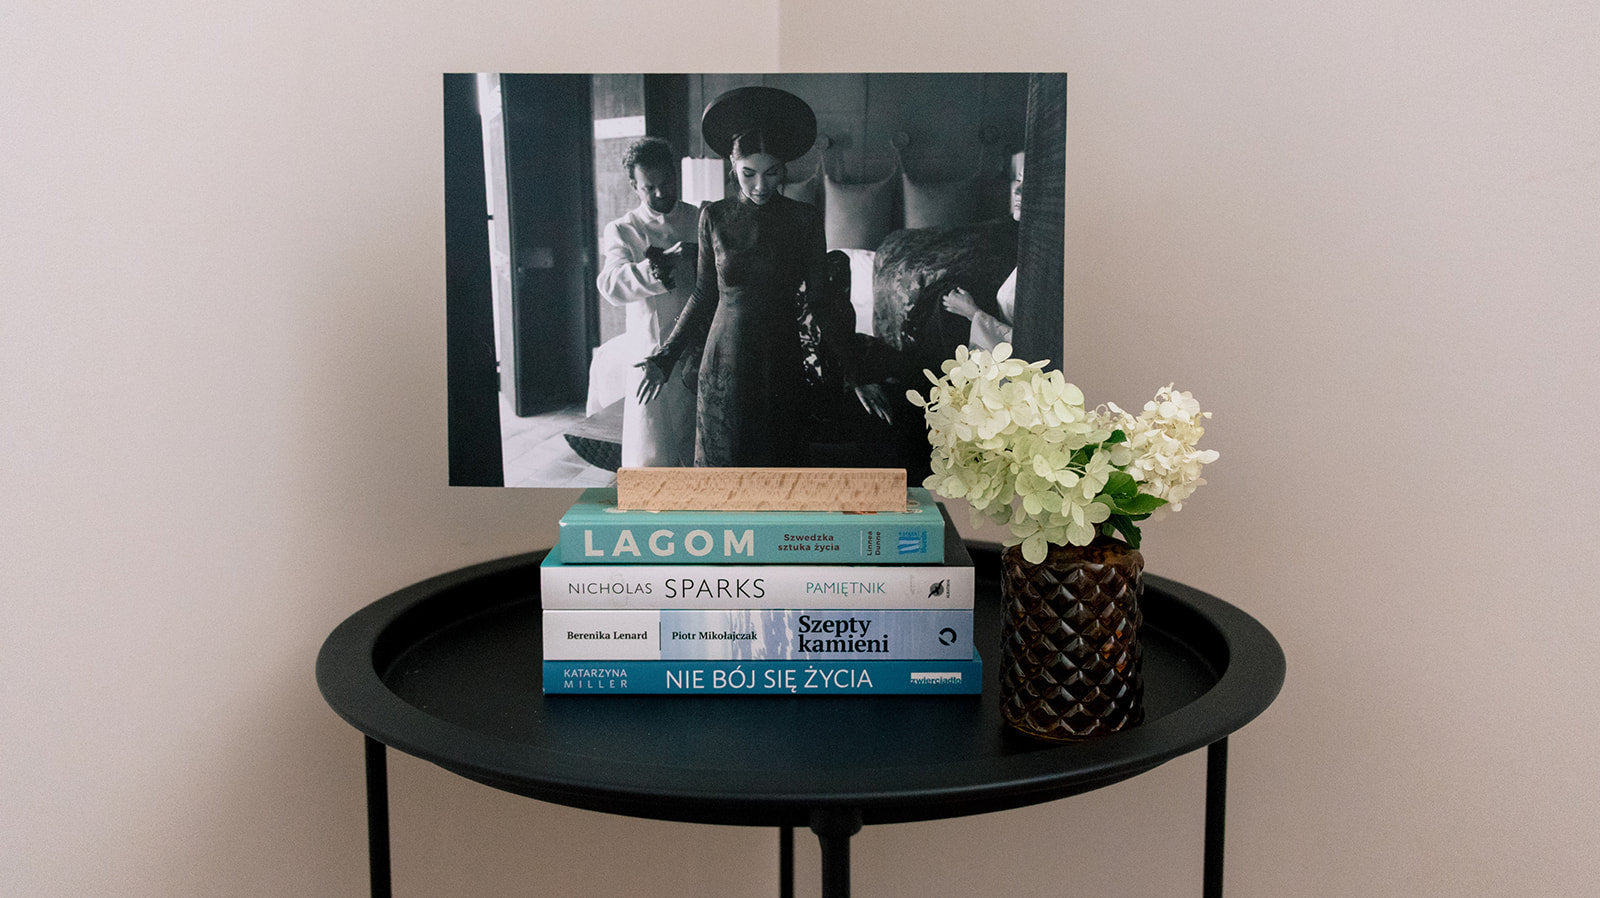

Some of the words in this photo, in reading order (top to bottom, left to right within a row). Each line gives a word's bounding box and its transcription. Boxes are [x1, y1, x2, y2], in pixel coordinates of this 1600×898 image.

[584, 529, 755, 557] LAGOM
[784, 533, 834, 541] Szwedzka
[778, 543, 811, 551] sztuka
[814, 543, 840, 552] życia
[568, 582, 653, 595] NICHOLAS
[665, 578, 766, 599] SPARKS
[806, 582, 886, 597] PAMIĘTNIK
[798, 615, 872, 637] Szepty
[567, 631, 611, 640] Berenika
[613, 631, 648, 640] Lenard
[671, 631, 697, 640] Piotr
[699, 631, 758, 642] Mikołajczak
[798, 634, 889, 653] kamieni
[563, 669, 628, 678] KATARZYNA
[666, 670, 705, 689] NIE
[713, 665, 756, 689] BÓJ
[764, 669, 797, 693] SIĘ
[804, 665, 874, 689] ŻYCIA
[563, 680, 628, 688] MILLER
